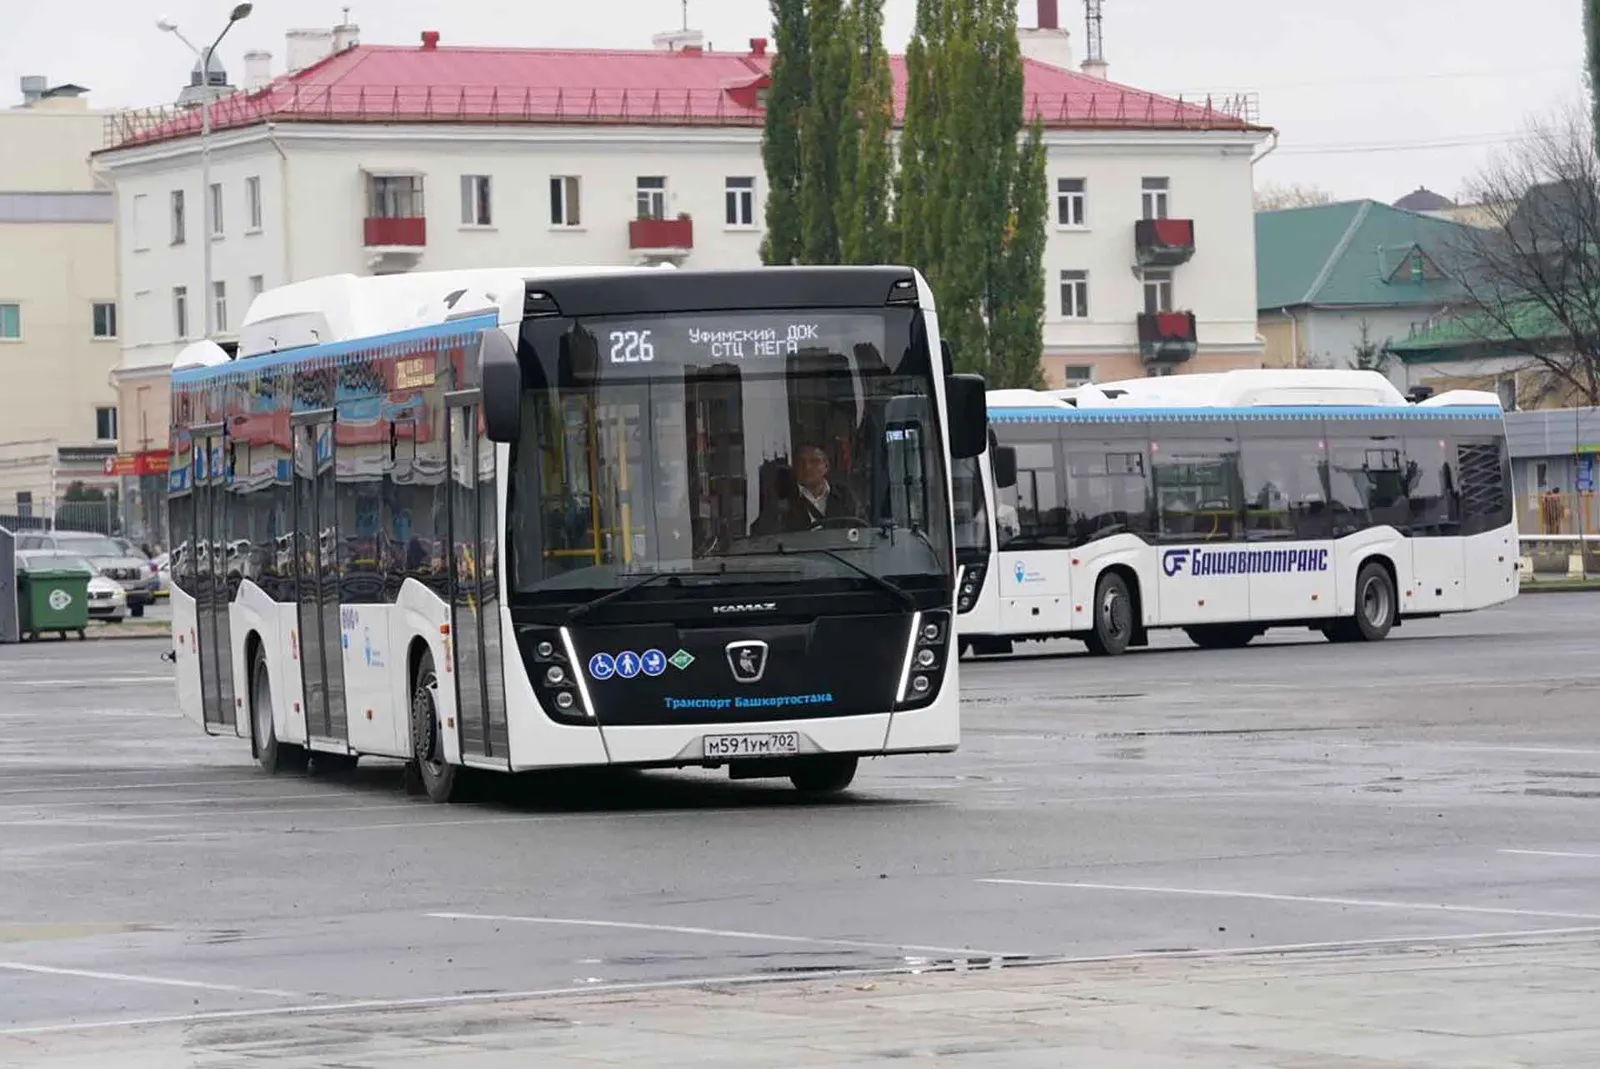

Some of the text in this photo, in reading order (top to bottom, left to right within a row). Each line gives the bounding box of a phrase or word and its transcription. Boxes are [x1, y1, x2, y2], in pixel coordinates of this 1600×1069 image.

[787, 324, 820, 342] ДОК
[609, 330, 655, 363] 226
[711, 339, 799, 358] СТЦ МЕГА
[664, 692, 833, 709] Транспорт Башкортостана
